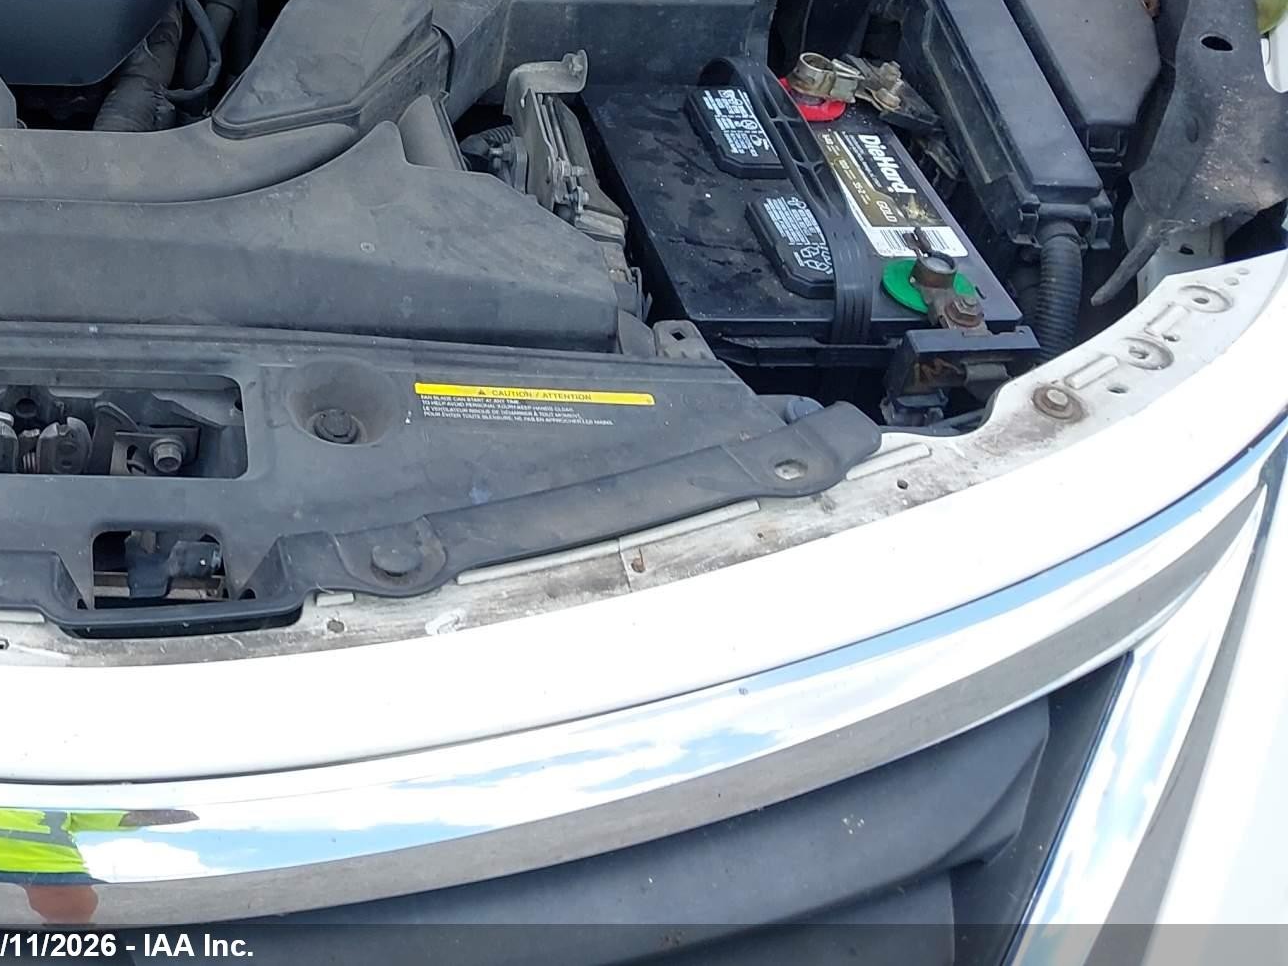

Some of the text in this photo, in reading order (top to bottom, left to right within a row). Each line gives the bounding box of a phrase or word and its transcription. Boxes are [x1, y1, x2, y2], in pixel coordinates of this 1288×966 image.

[858, 134, 917, 193] DieHard
[876, 200, 898, 223] GOLD
[543, 392, 592, 400] ATTENTION
